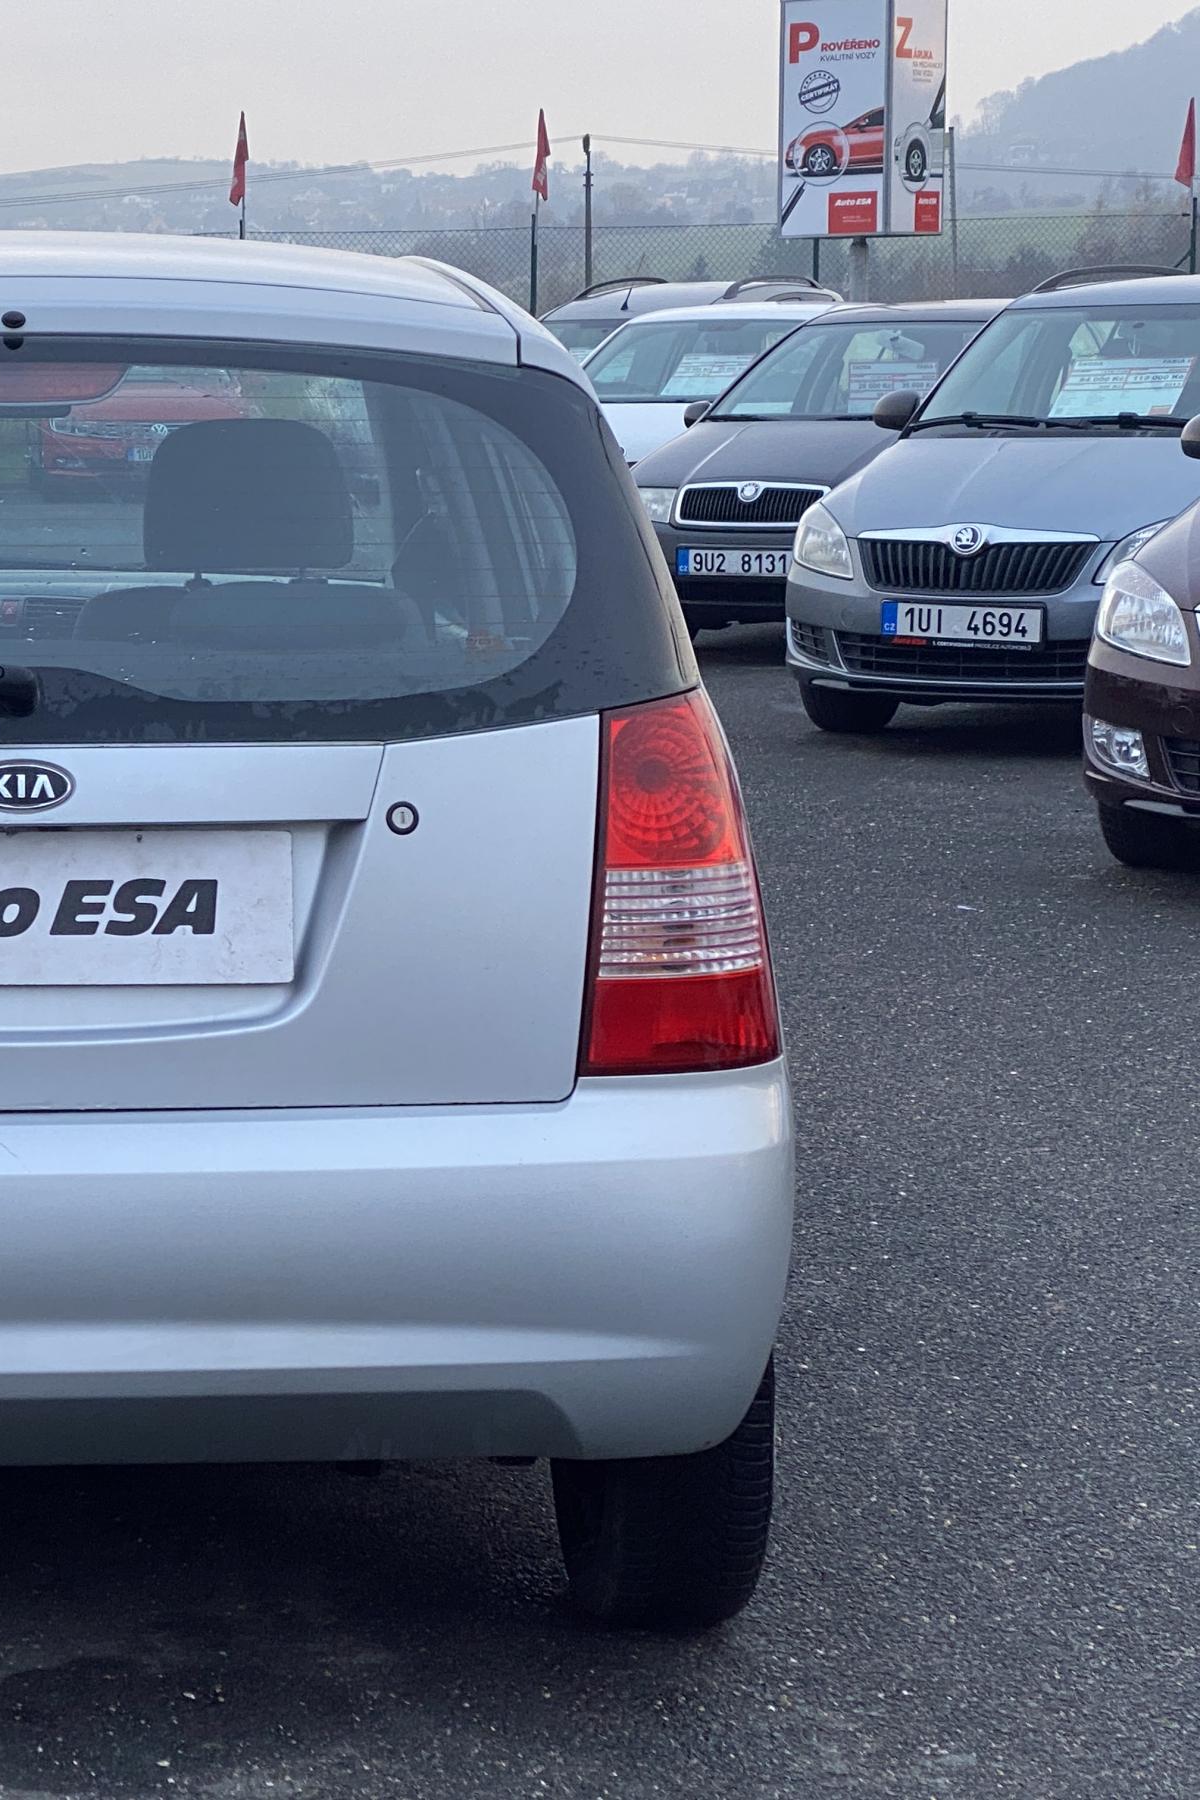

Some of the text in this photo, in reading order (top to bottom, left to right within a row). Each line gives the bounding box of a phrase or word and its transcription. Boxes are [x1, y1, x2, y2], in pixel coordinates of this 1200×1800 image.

[820, 51, 876, 62] KVALITNÍ VOZY
[856, 198, 872, 206] ESA
[693, 552, 726, 573] 9U2
[741, 553, 787, 574] 8131
[884, 607, 1028, 638] CZ 1UI 4694
[49, 878, 218, 936] ESA
